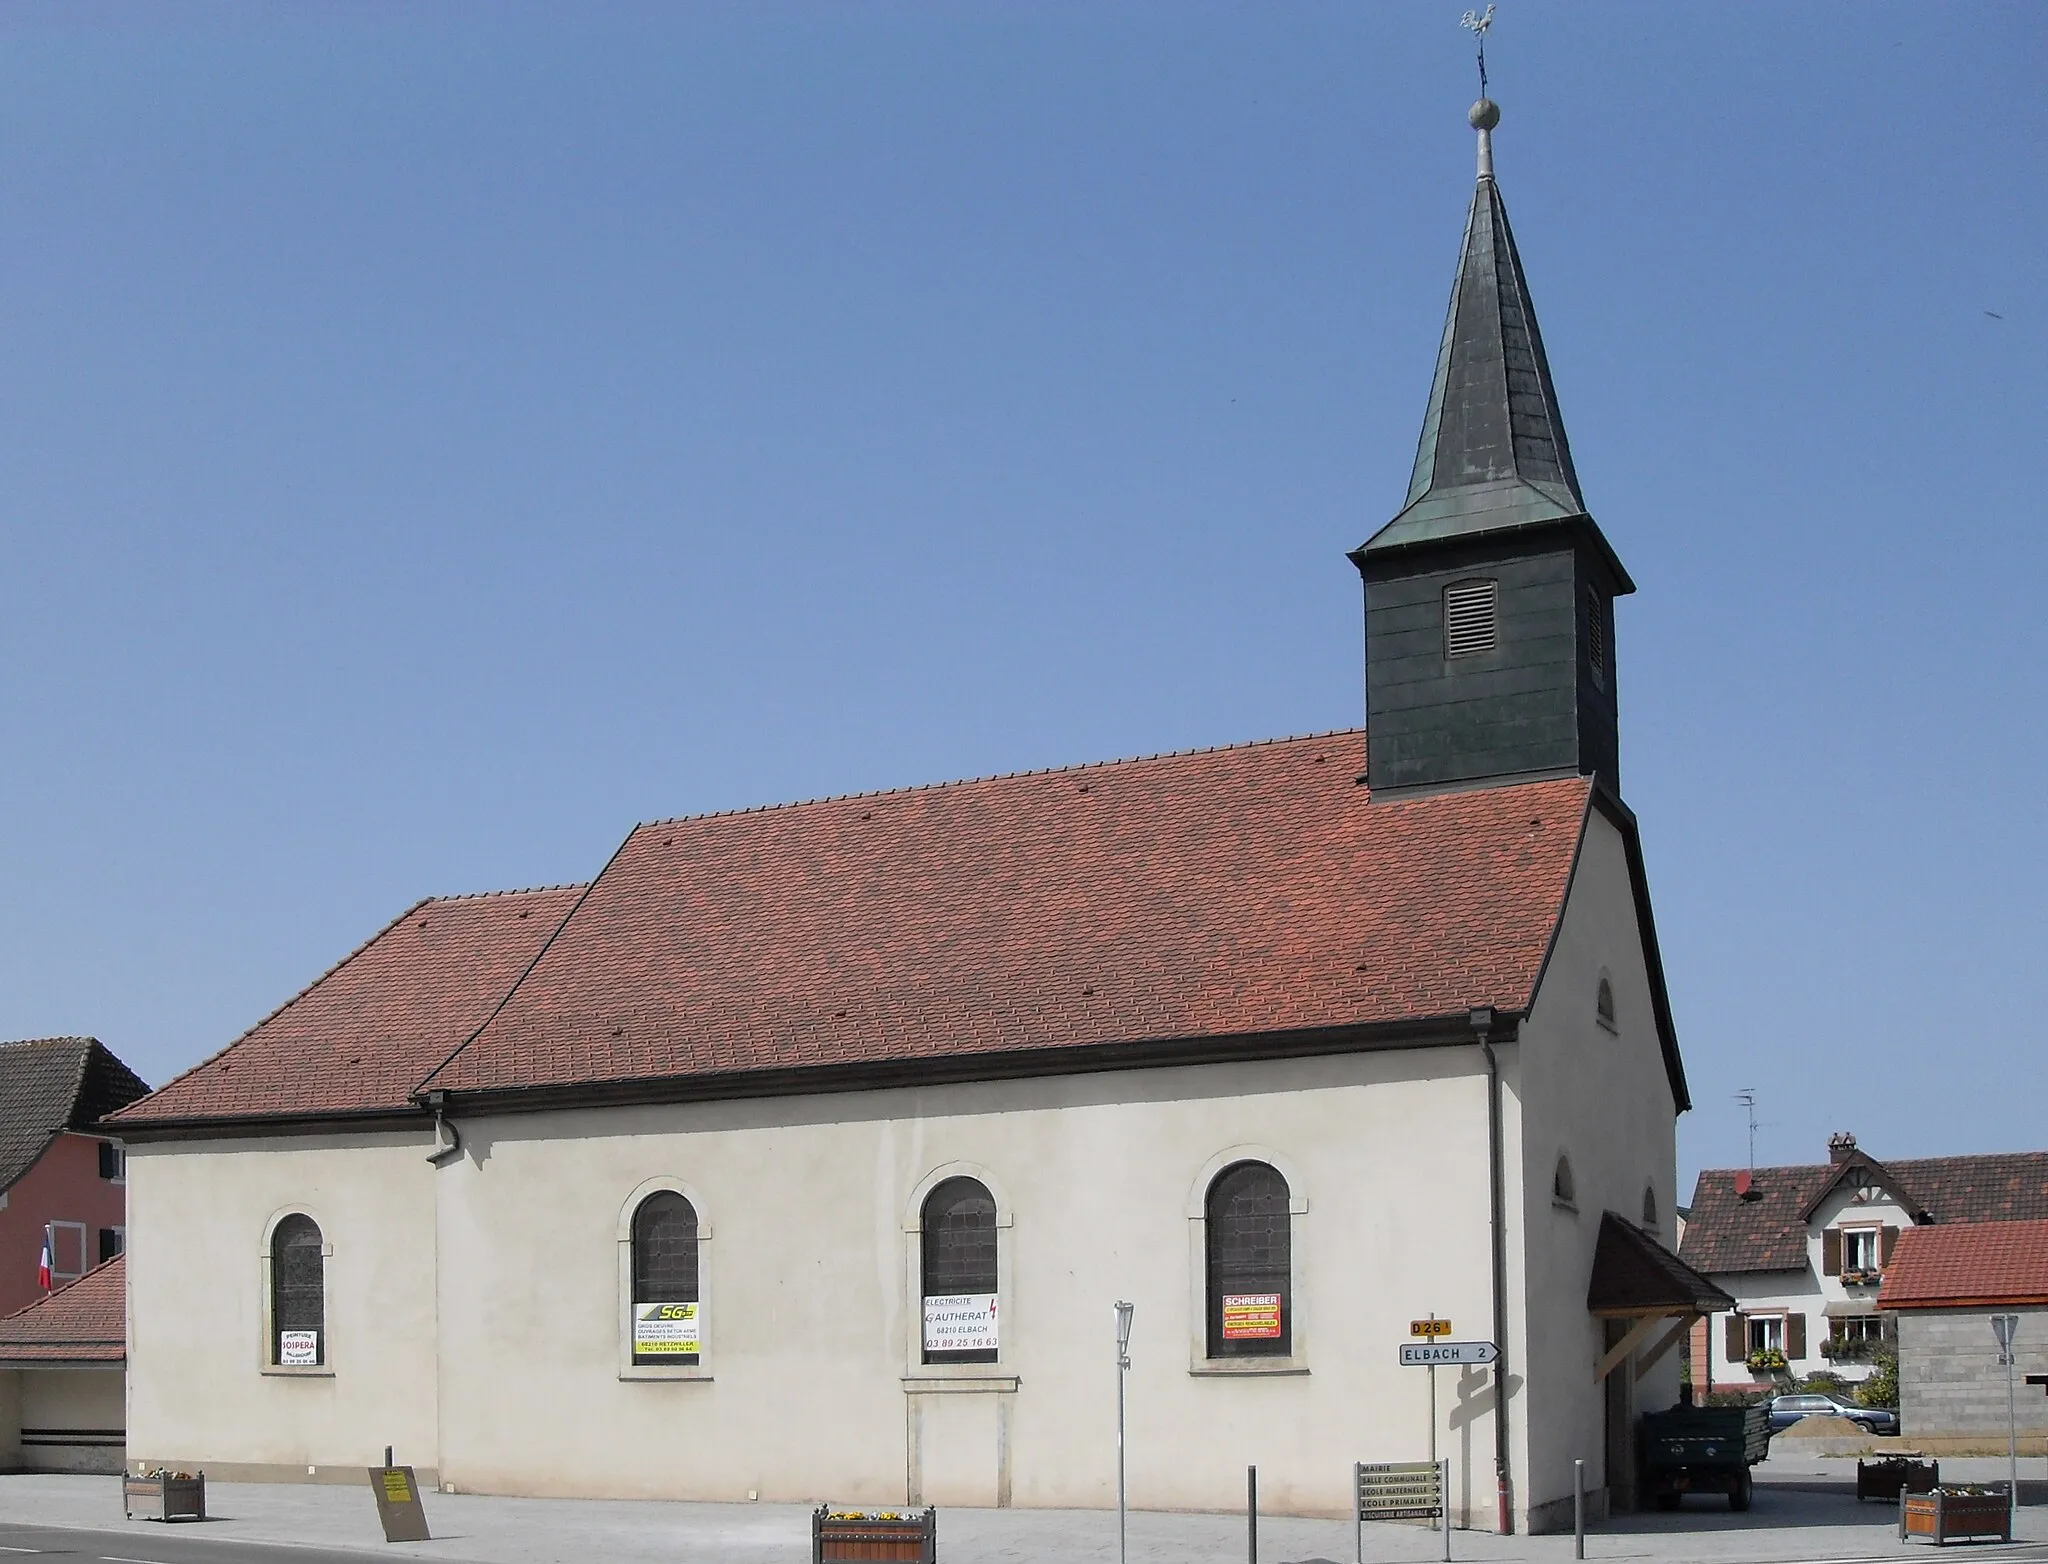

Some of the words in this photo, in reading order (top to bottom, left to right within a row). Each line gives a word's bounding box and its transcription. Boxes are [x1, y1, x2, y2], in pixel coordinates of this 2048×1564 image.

[1225, 1296, 1277, 1305] SCHREIBER
[925, 1311, 987, 1323] GAUTHERAT
[936, 1326, 957, 1334] 68210
[958, 1325, 988, 1333] ELBACH
[1412, 1323, 1420, 1333] D
[1424, 1322, 1441, 1333] 26
[283, 1341, 314, 1349] SOSPERA
[927, 1339, 939, 1347] 03
[941, 1338, 954, 1347] 89
[956, 1338, 968, 1346] 25
[972, 1338, 982, 1346] 16
[985, 1337, 997, 1346] 63
[1405, 1348, 1460, 1360] ELBACH
[1478, 1348, 1486, 1358] 2
[1384, 1475, 1427, 1484] COMMUNALE
[1362, 1488, 1383, 1496] ECOLE
[1385, 1486, 1427, 1494] MATERNELLE
